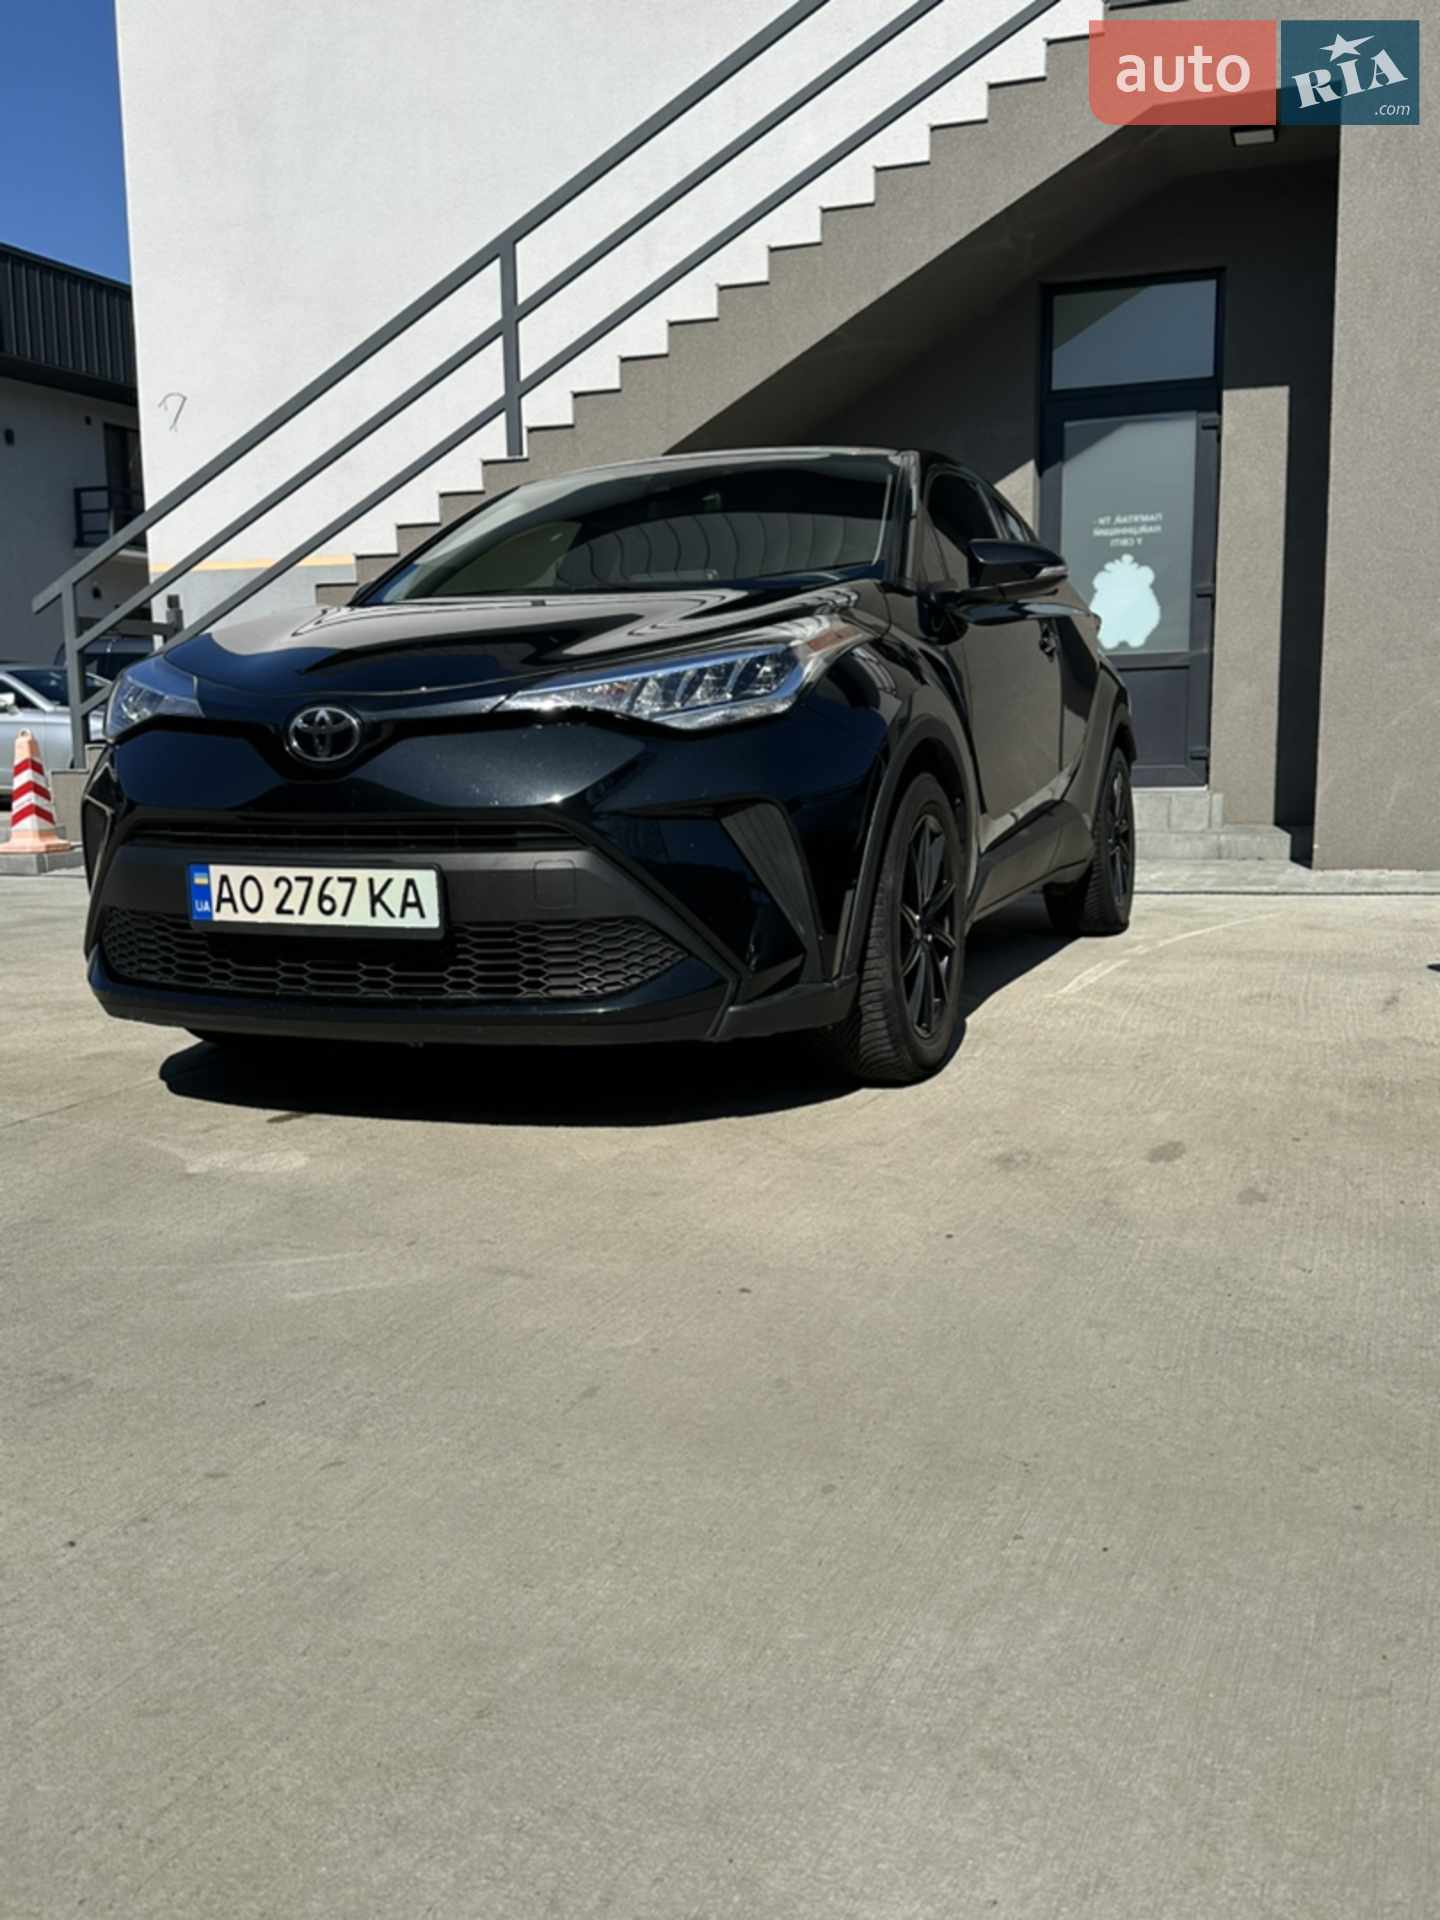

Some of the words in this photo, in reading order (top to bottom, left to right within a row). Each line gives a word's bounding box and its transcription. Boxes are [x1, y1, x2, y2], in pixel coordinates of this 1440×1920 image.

[195, 900, 211, 913] UA
[215, 874, 264, 914] AO
[274, 876, 357, 917] 2767
[368, 877, 426, 919] KA
